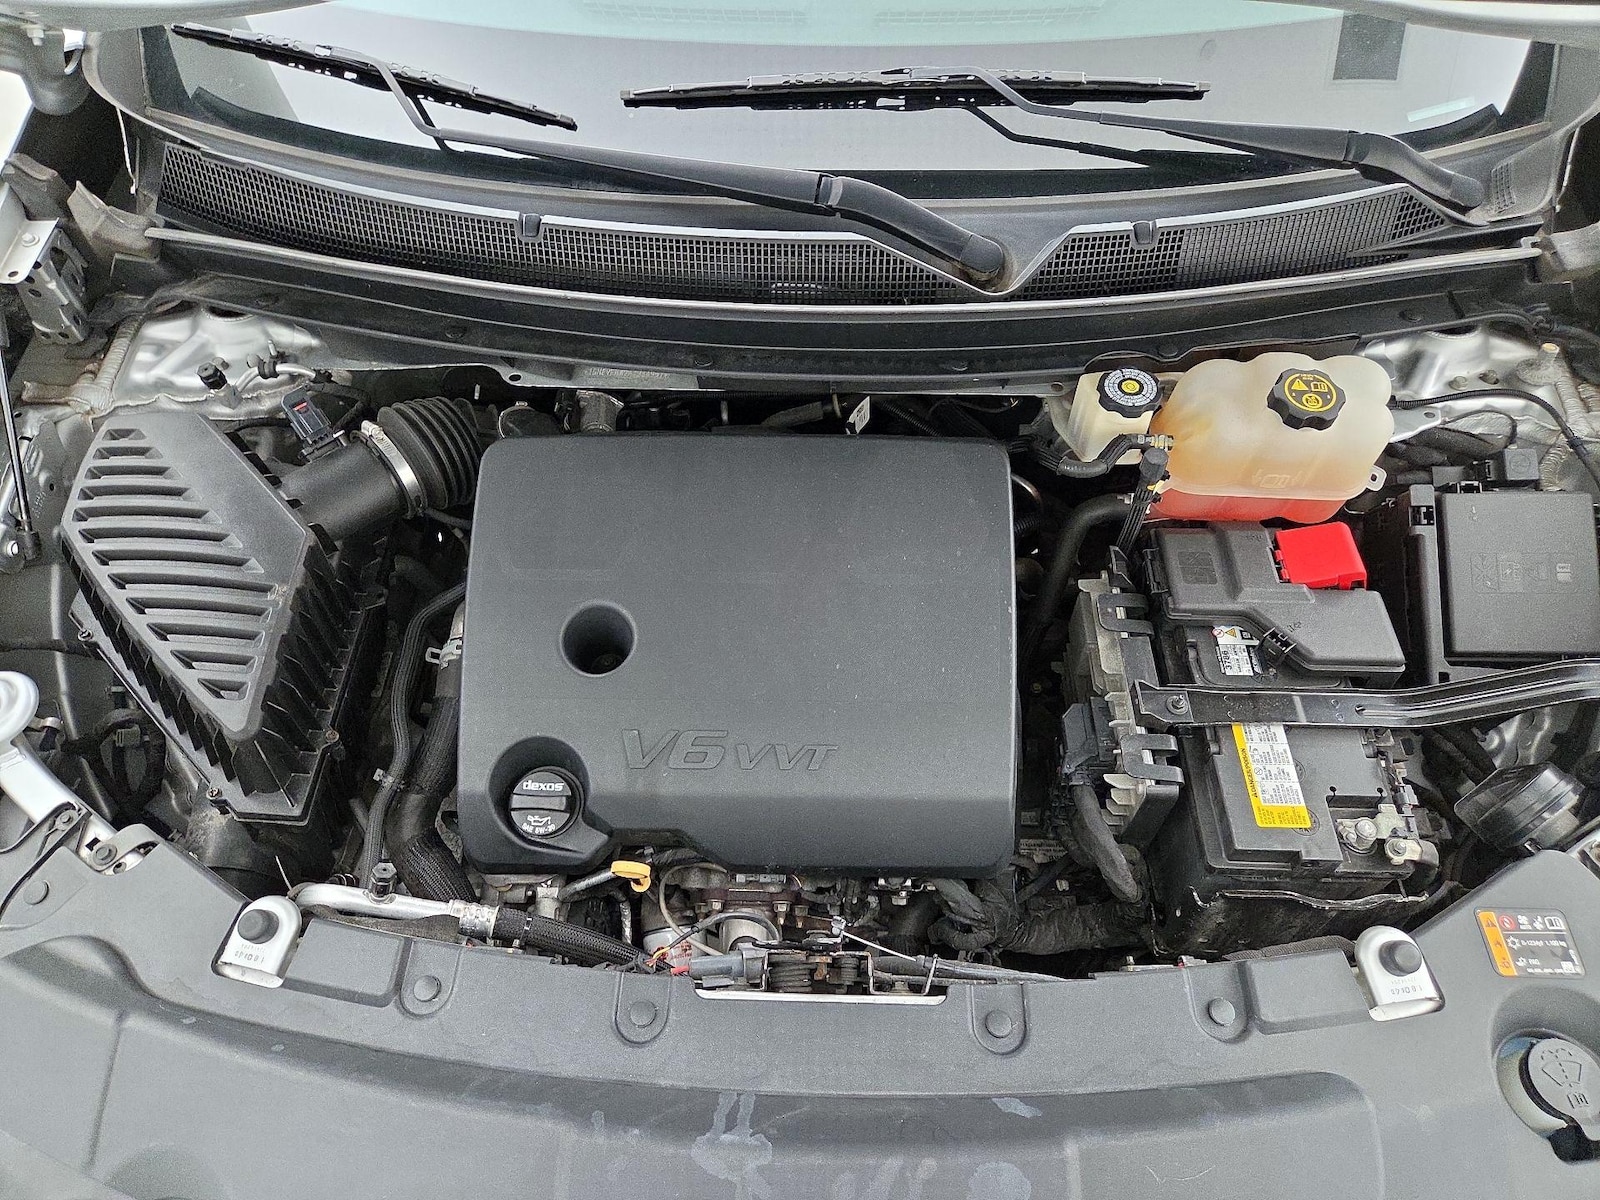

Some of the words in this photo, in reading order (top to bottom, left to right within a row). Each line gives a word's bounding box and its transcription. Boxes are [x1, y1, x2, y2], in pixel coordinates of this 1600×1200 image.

[621, 728, 729, 770] V6
[735, 743, 839, 771] VVT
[522, 780, 564, 791] dexos
[521, 822, 534, 833] SAE
